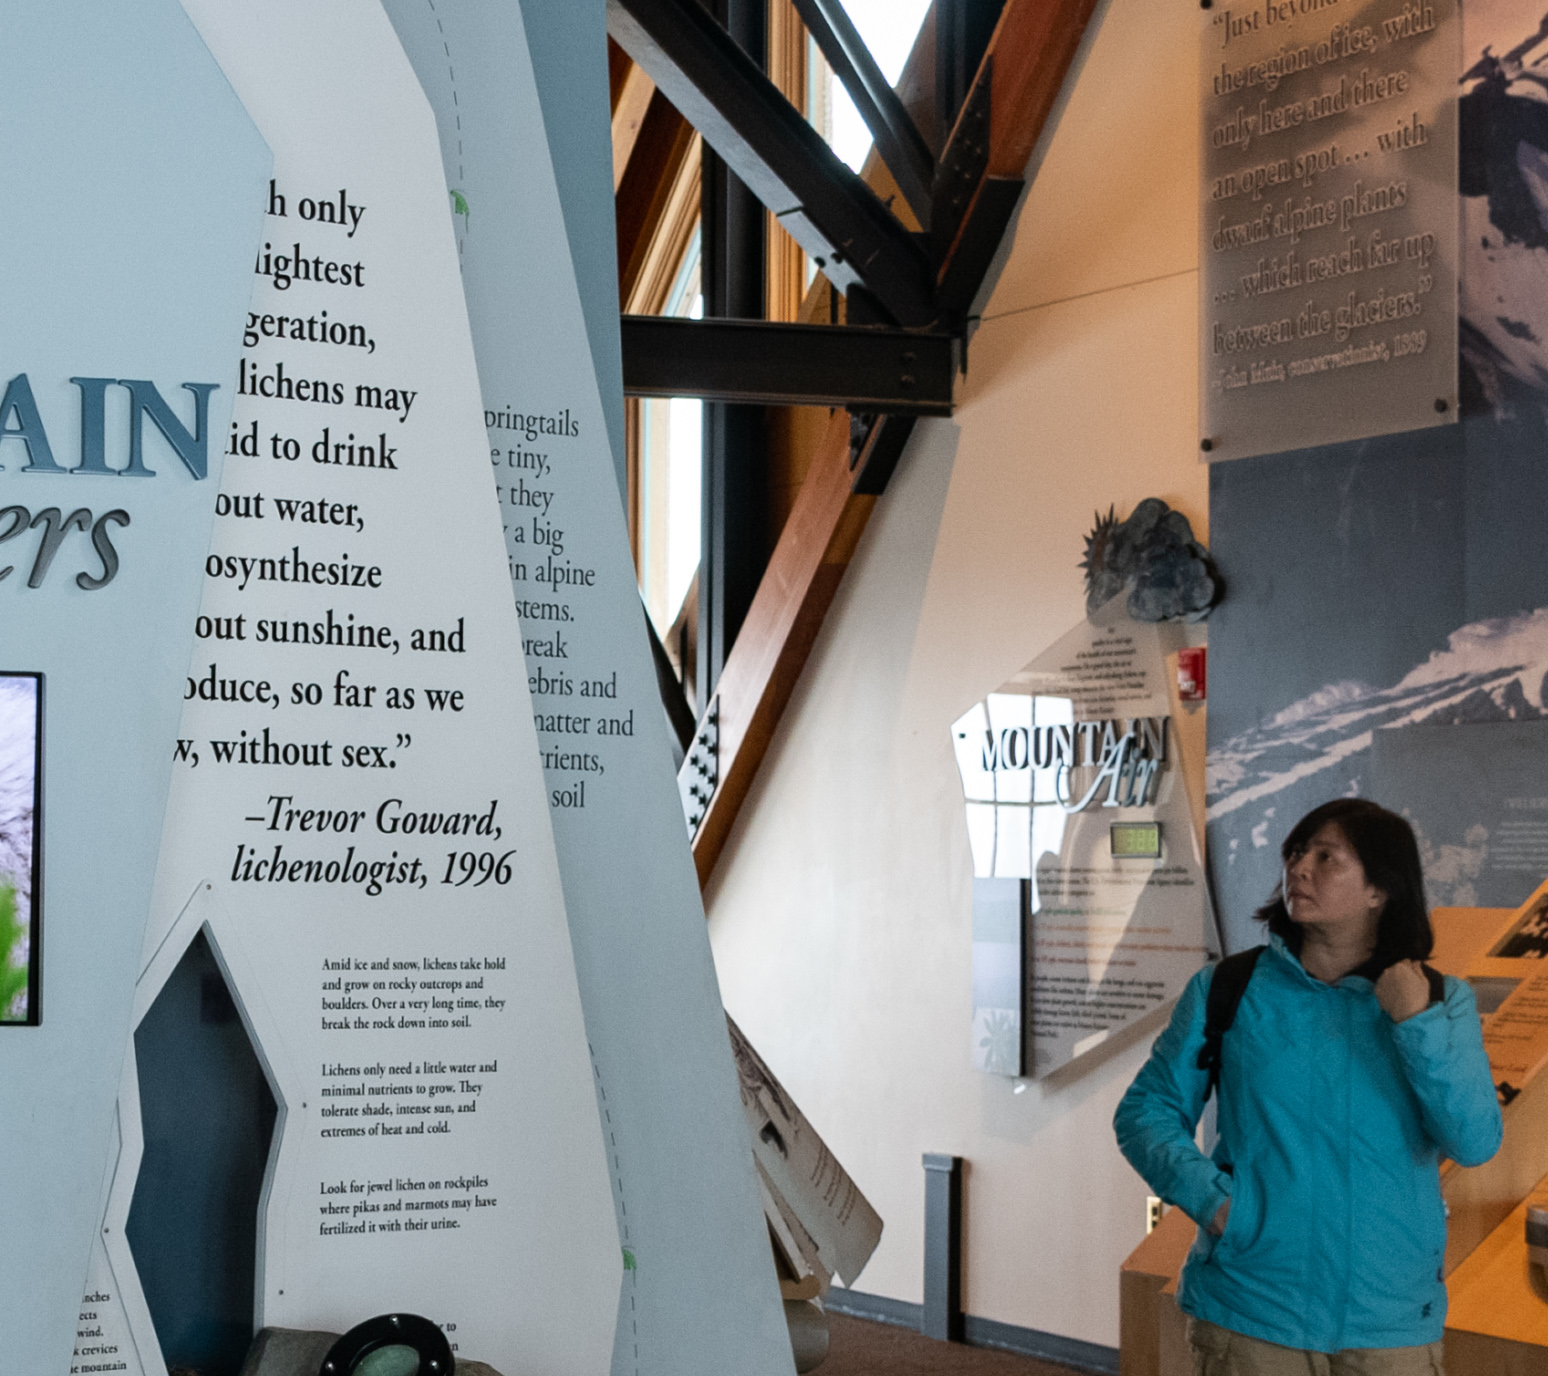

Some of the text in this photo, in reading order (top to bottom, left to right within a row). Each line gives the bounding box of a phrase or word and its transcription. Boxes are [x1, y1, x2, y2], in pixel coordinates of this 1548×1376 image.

[1212, 62, 1245, 97] the
[1248, 45, 1312, 91] region
[1316, 24, 1341, 65] of
[1341, 24, 1379, 54] ice,
[1212, 177, 1238, 202] an
[1241, 157, 1293, 201] open
[1294, 143, 1339, 188] spot
[1376, 111, 1428, 155] with
[298, 188, 366, 238] only
[237, 357, 418, 423] lichens may
[270, 427, 398, 470] to drink
[507, 443, 551, 479] tiny,
[215, 492, 364, 533] out water,
[510, 477, 554, 516] they
[514, 516, 564, 556] a big
[205, 545, 382, 591] osynthesize
[535, 555, 595, 593] alpine
[195, 608, 466, 655] out sunshine, and
[290, 682, 323, 705] so
[333, 669, 377, 707] far
[386, 687, 415, 710] as
[423, 689, 464, 712] we
[580, 671, 617, 699] and
[597, 708, 634, 736] and
[209, 727, 333, 766] without
[981, 716, 1170, 772] MOUNTAIN
[1055, 730, 1160, 814] Air
[551, 780, 585, 808] soil
[376, 798, 502, 841] Goward,
[231, 844, 517, 896] lichenologist, 1996
[322, 957, 506, 970] Amid ice and snow, lichens take hold
[322, 976, 484, 994] and grow on rocky outcrops and
[320, 1174, 489, 1196] Look for jewel lichen on rockpiles
